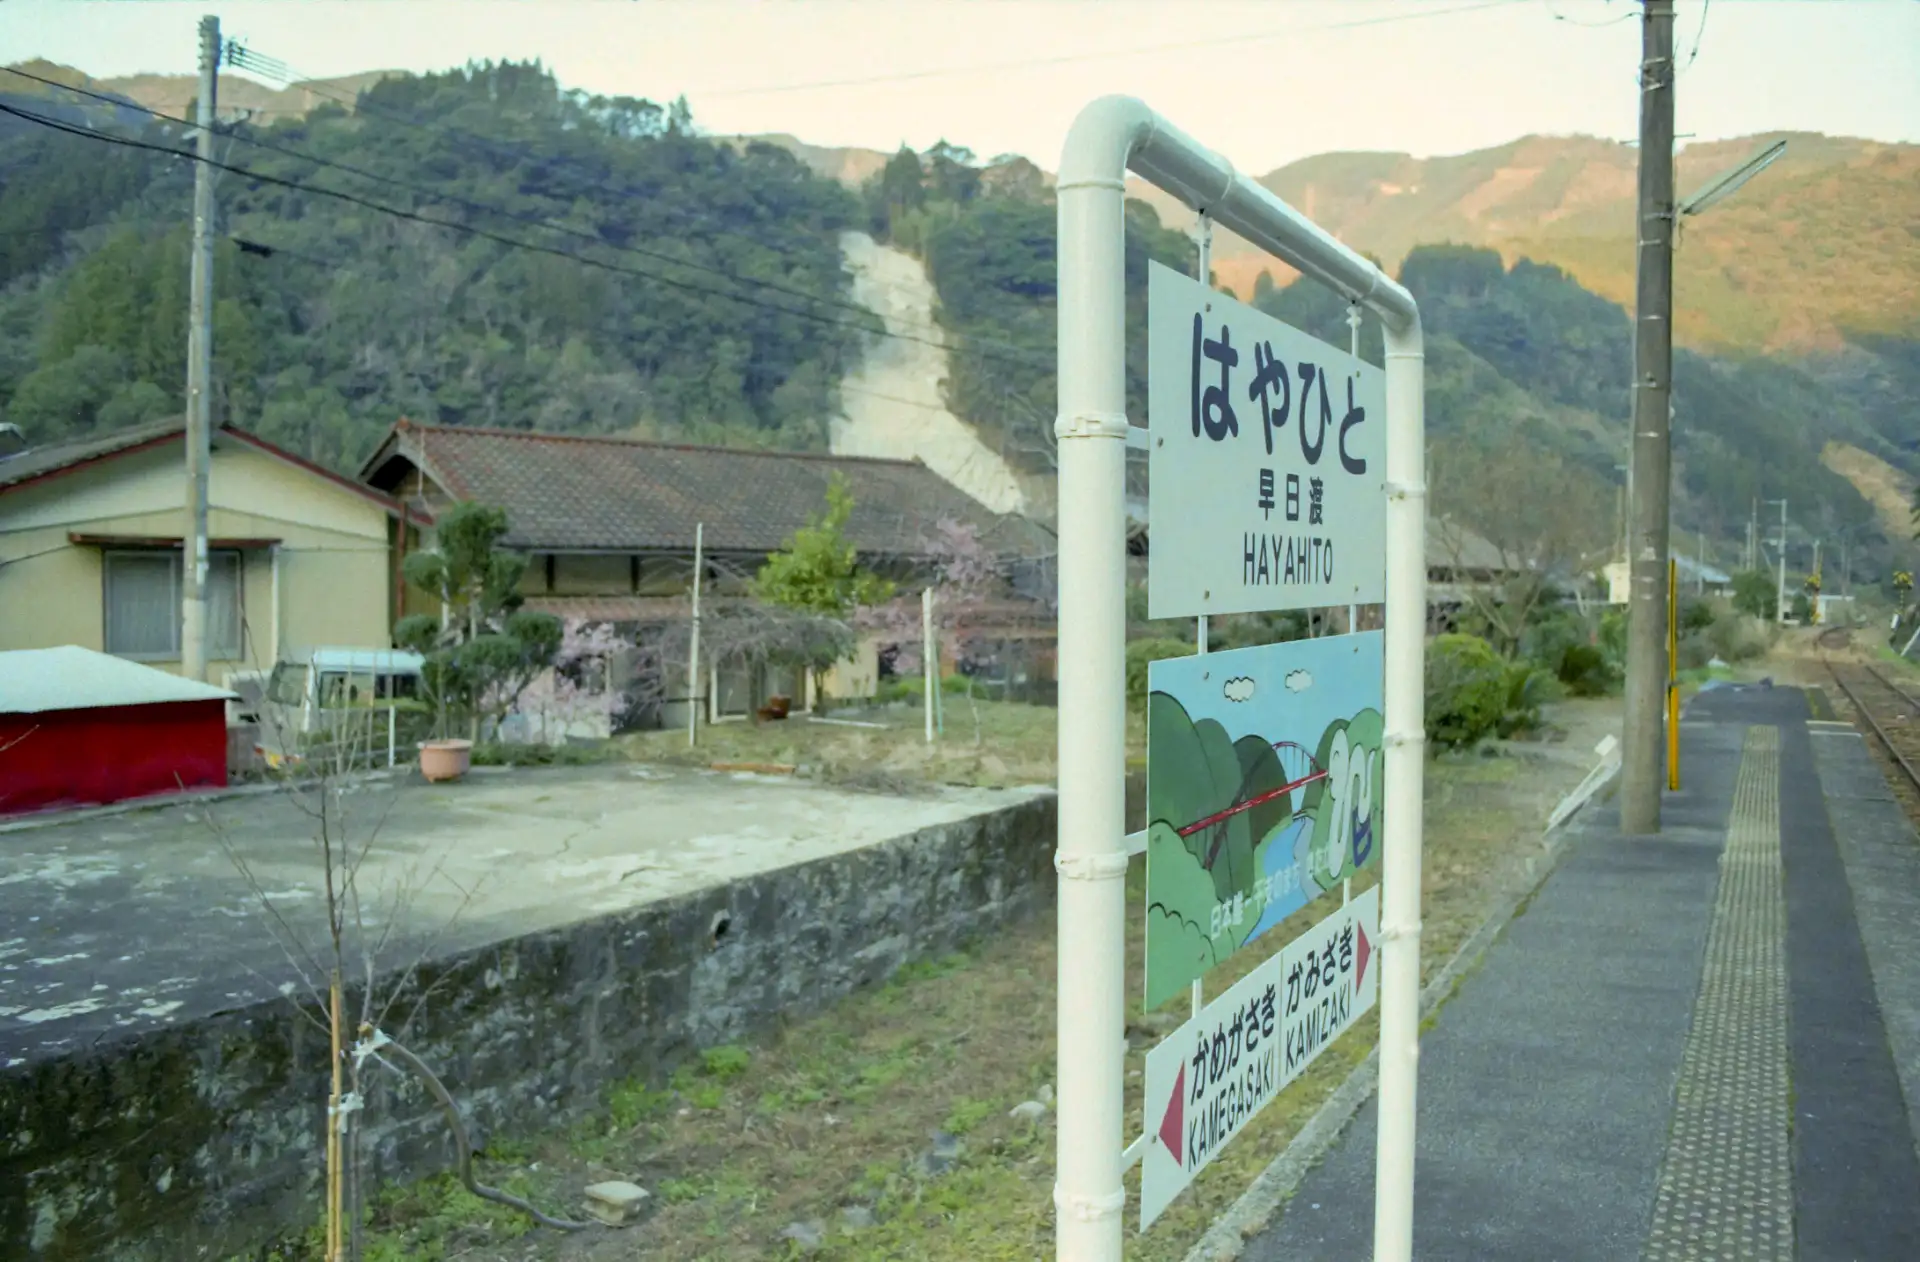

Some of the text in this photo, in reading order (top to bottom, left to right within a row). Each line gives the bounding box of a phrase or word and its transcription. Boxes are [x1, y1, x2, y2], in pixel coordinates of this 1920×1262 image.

[1191, 312, 1367, 475] はやひと
[1258, 468, 1324, 525] 早日渡
[1243, 531, 1333, 586] HAYAHITO
[1188, 978, 1350, 1173] KAMEGASAKI KAMIZAKI
[1190, 983, 1276, 1106] かめがさき
